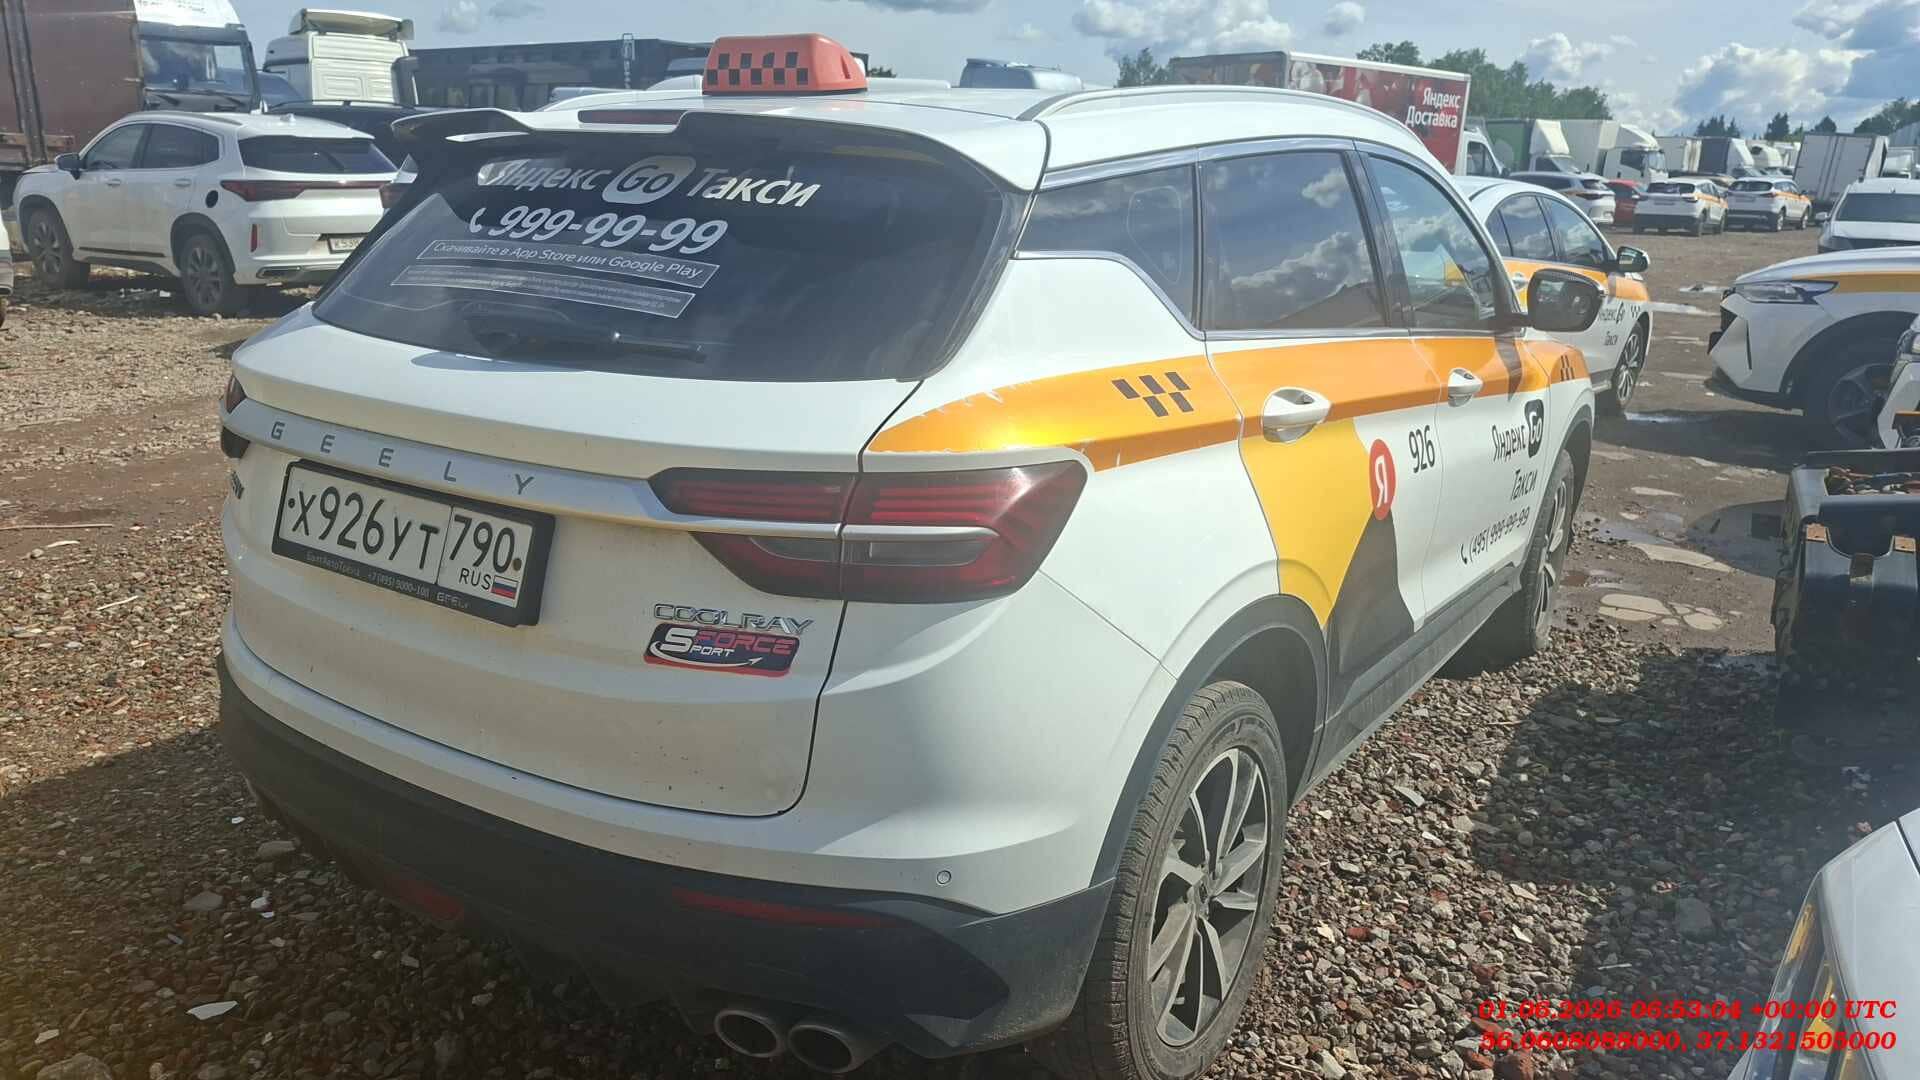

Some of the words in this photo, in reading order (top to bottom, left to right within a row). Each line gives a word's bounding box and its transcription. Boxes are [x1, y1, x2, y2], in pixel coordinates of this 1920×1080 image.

[1404, 105, 1458, 129] Доставка
[1422, 87, 1462, 109] Яндекс
[495, 158, 613, 191] Яндекс
[687, 166, 822, 207] Такси
[487, 205, 729, 255] 999-99-99
[510, 247, 539, 261] App
[540, 249, 576, 263] Store
[577, 254, 607, 266] или
[608, 255, 666, 275] Google
[667, 263, 704, 280] Play
[270, 420, 535, 496] GEELY
[1408, 424, 1436, 474] 926
[1491, 424, 1526, 462] Яндекс
[1511, 468, 1538, 501] Такси
[291, 485, 440, 571] Х926УТ
[448, 514, 516, 574] 790
[1469, 527, 1489, 563] (495)
[1490, 505, 1531, 545] 999-99-99
[458, 567, 491, 591] RUS
[654, 603, 814, 634] COOLRAY
